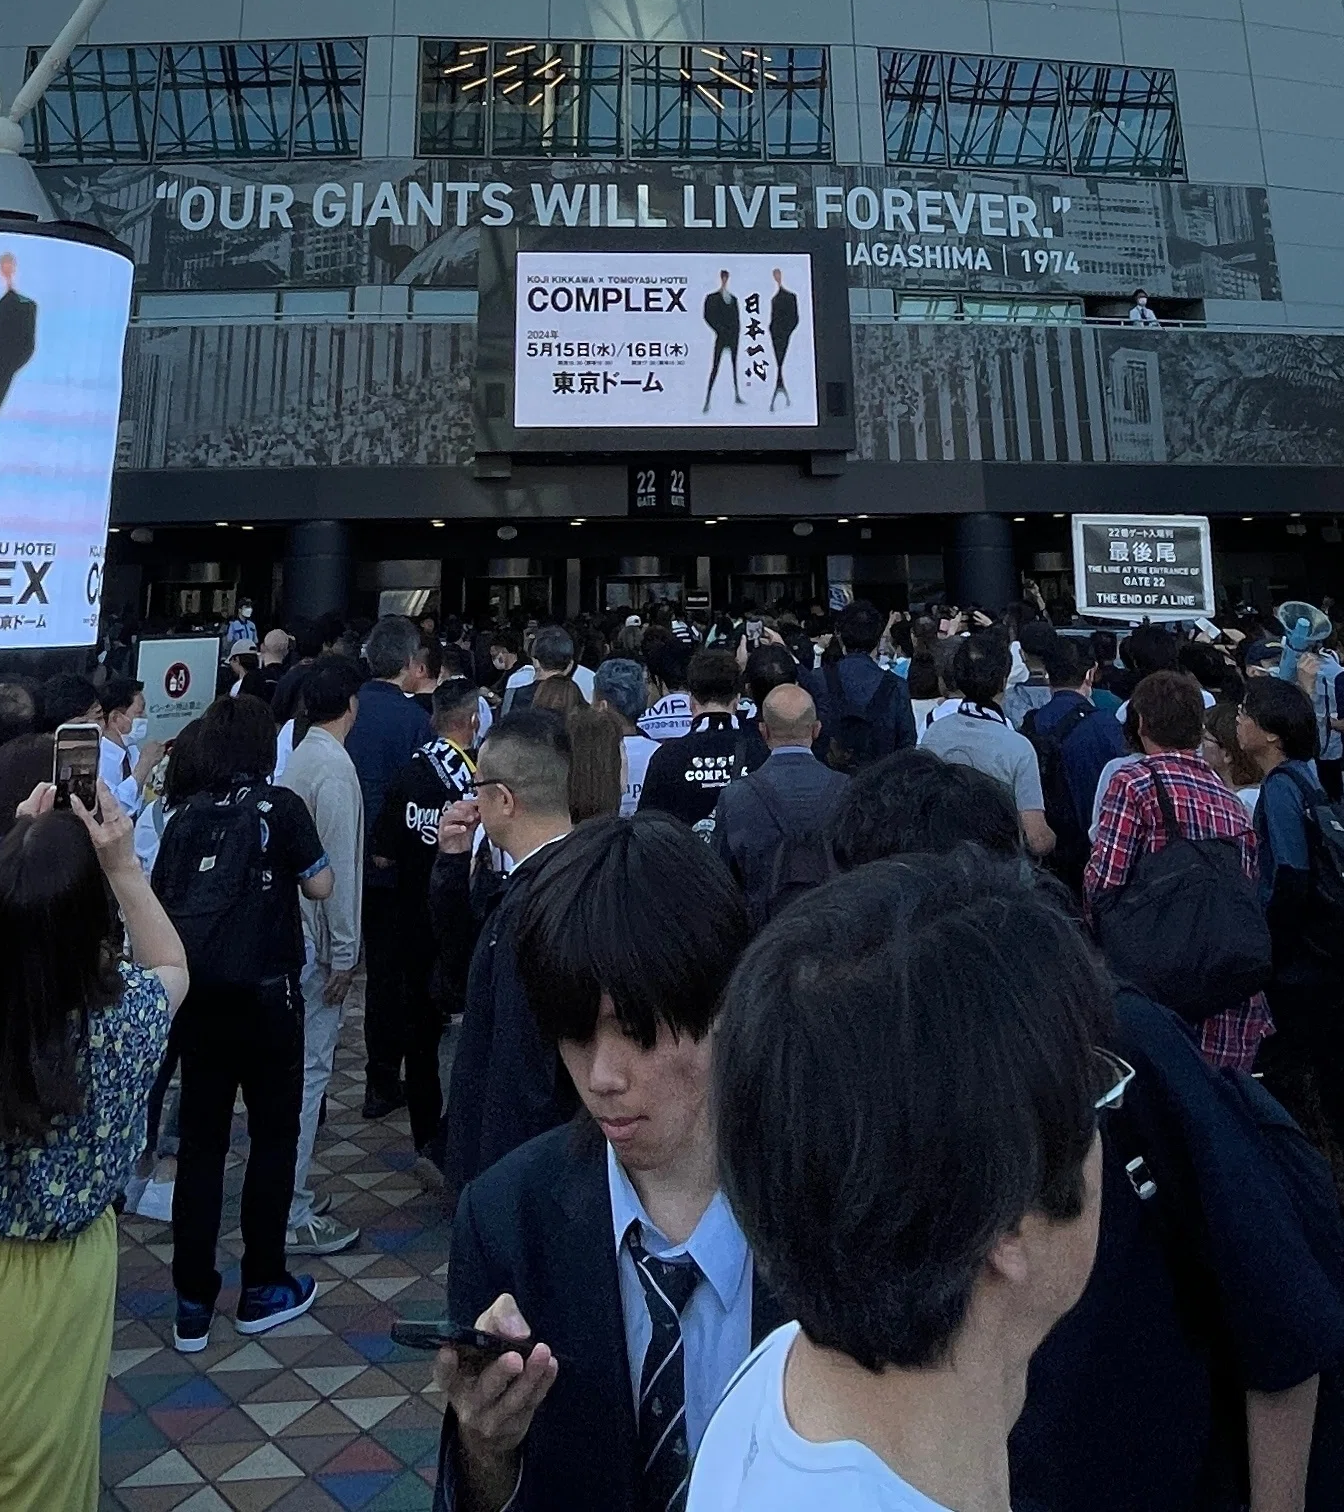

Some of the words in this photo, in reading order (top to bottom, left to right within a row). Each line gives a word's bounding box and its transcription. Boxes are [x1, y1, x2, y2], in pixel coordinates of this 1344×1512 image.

[312, 182, 513, 229] GIANTS
[531, 183, 666, 229] WILL
[683, 185, 799, 229] LIVE
[1021, 249, 1081, 276] 1974
[527, 276, 550, 284] KOJI
[552, 276, 595, 284] KIKKAWA
[608, 276, 658, 285] TOMOYASU
[660, 277, 688, 285] HOTEI
[527, 287, 688, 313] COMPLEX
[527, 331, 559, 340] 2024年
[744, 293, 769, 382] 日本一心
[552, 372, 665, 395] 東京ドーム
[637, 470, 656, 494] 22
[671, 469, 685, 494] 22
[14, 542, 56, 556] HOTEI
[1109, 541, 1177, 563] 最後尾
[1088, 565, 1102, 574] THE
[1103, 565, 1121, 574] LINE
[1122, 566, 1132, 574] AT
[1133, 566, 1148, 575] THE
[1149, 566, 1188, 575] ENTRANCE
[1190, 568, 1200, 576] OF
[1123, 576, 1151, 587] GATE
[1153, 577, 1166, 587] 22
[1096, 593, 1118, 604] THE
[1120, 593, 1142, 605] END
[1144, 594, 1159, 605] OF
[1161, 594, 1169, 605] A
[1171, 594, 1196, 606] LINE
